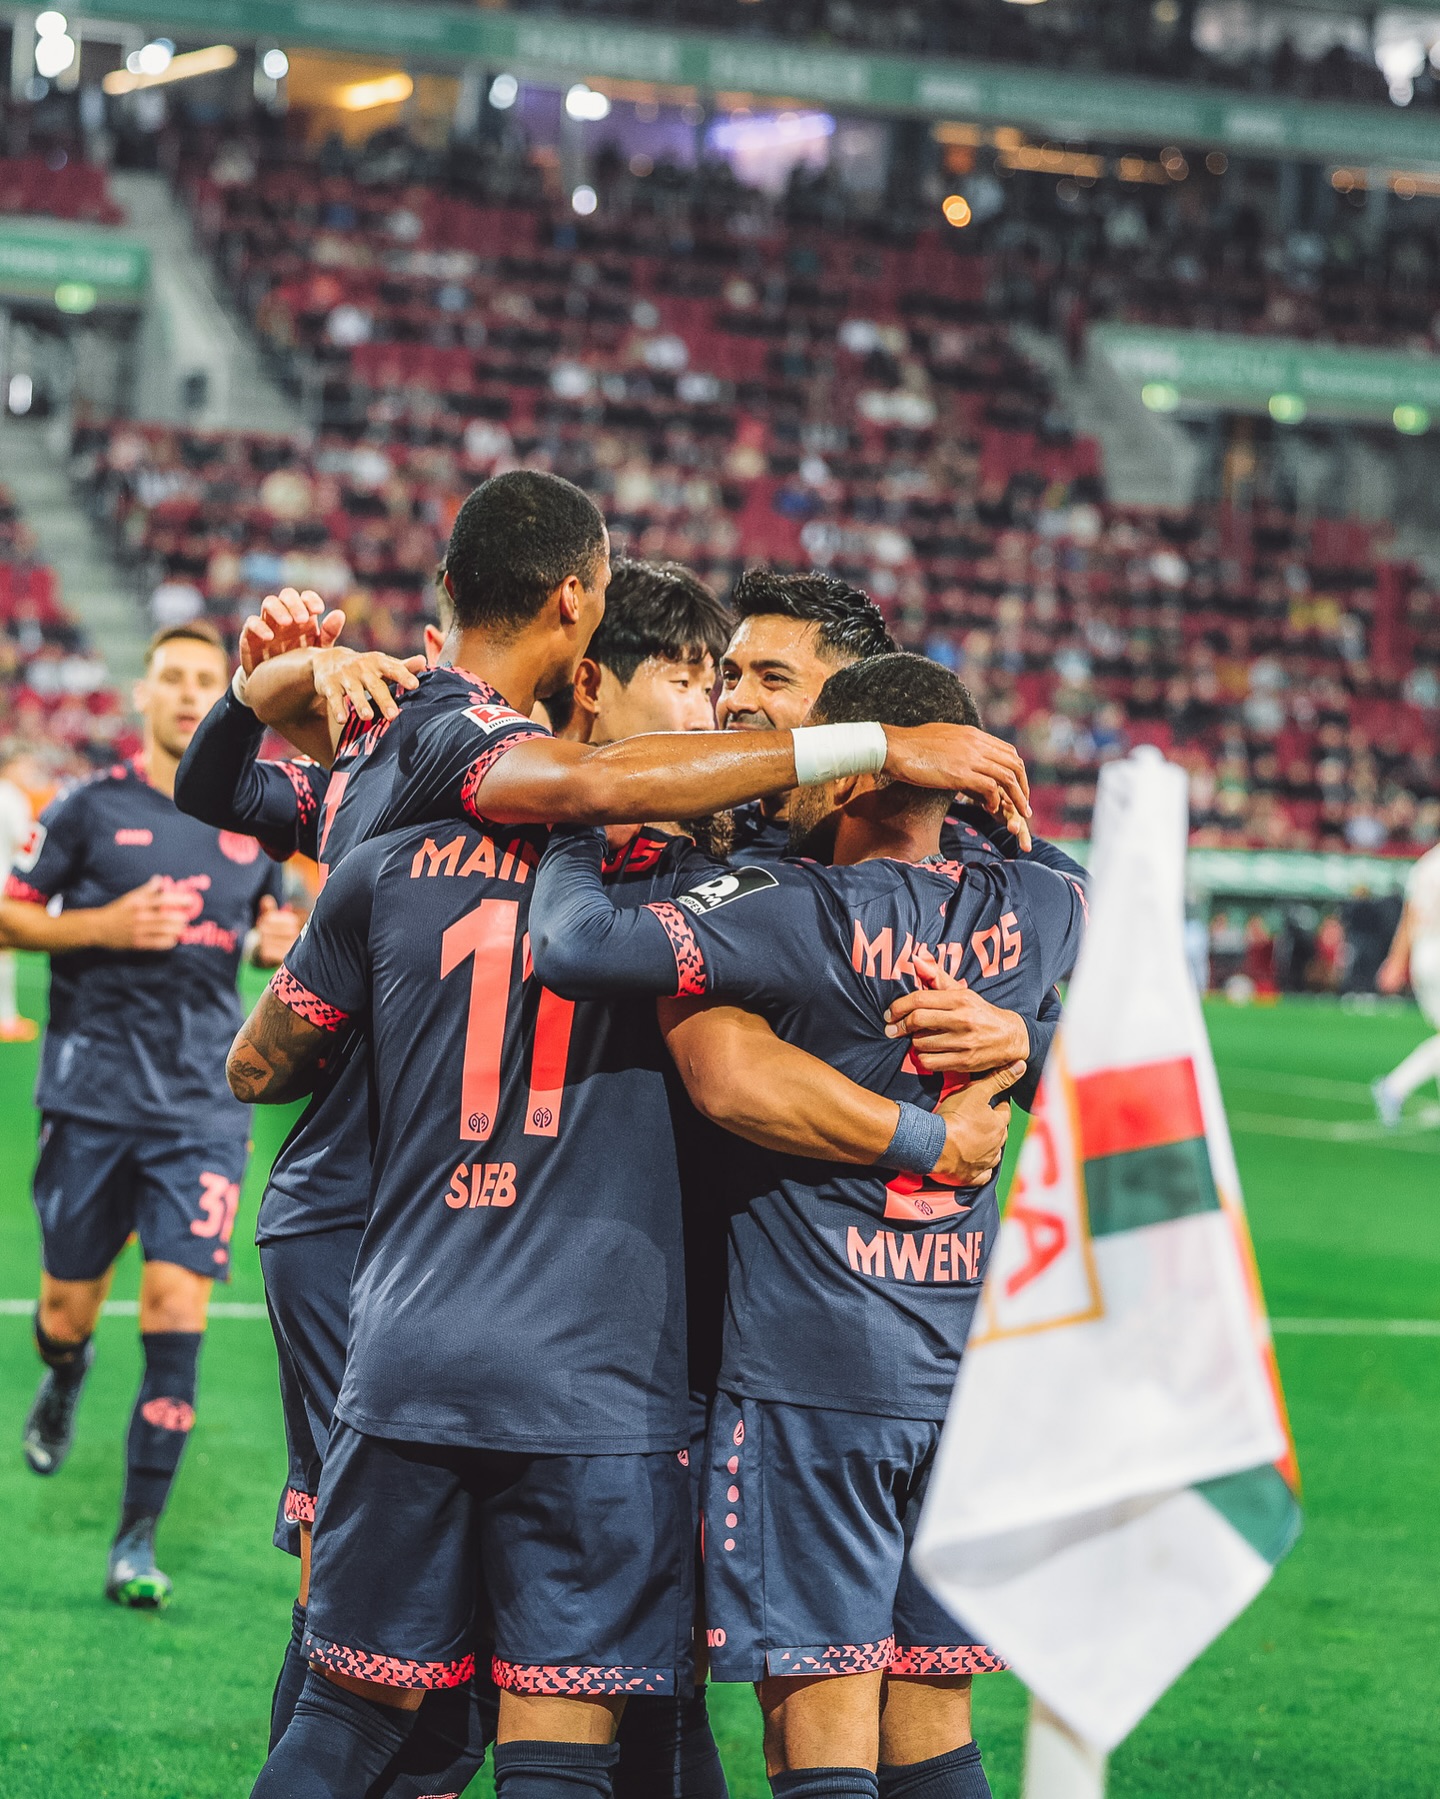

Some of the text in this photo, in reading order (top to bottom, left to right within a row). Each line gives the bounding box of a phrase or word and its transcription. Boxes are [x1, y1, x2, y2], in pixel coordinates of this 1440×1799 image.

[410, 835, 541, 884] MAIN
[971, 911, 1022, 978] 05
[440, 898, 576, 1141] 11
[190, 1171, 240, 1242] 31
[444, 1162, 517, 1209] SIEB
[846, 1226, 983, 1282] MWENE
[706, 1628, 727, 1648] KO
